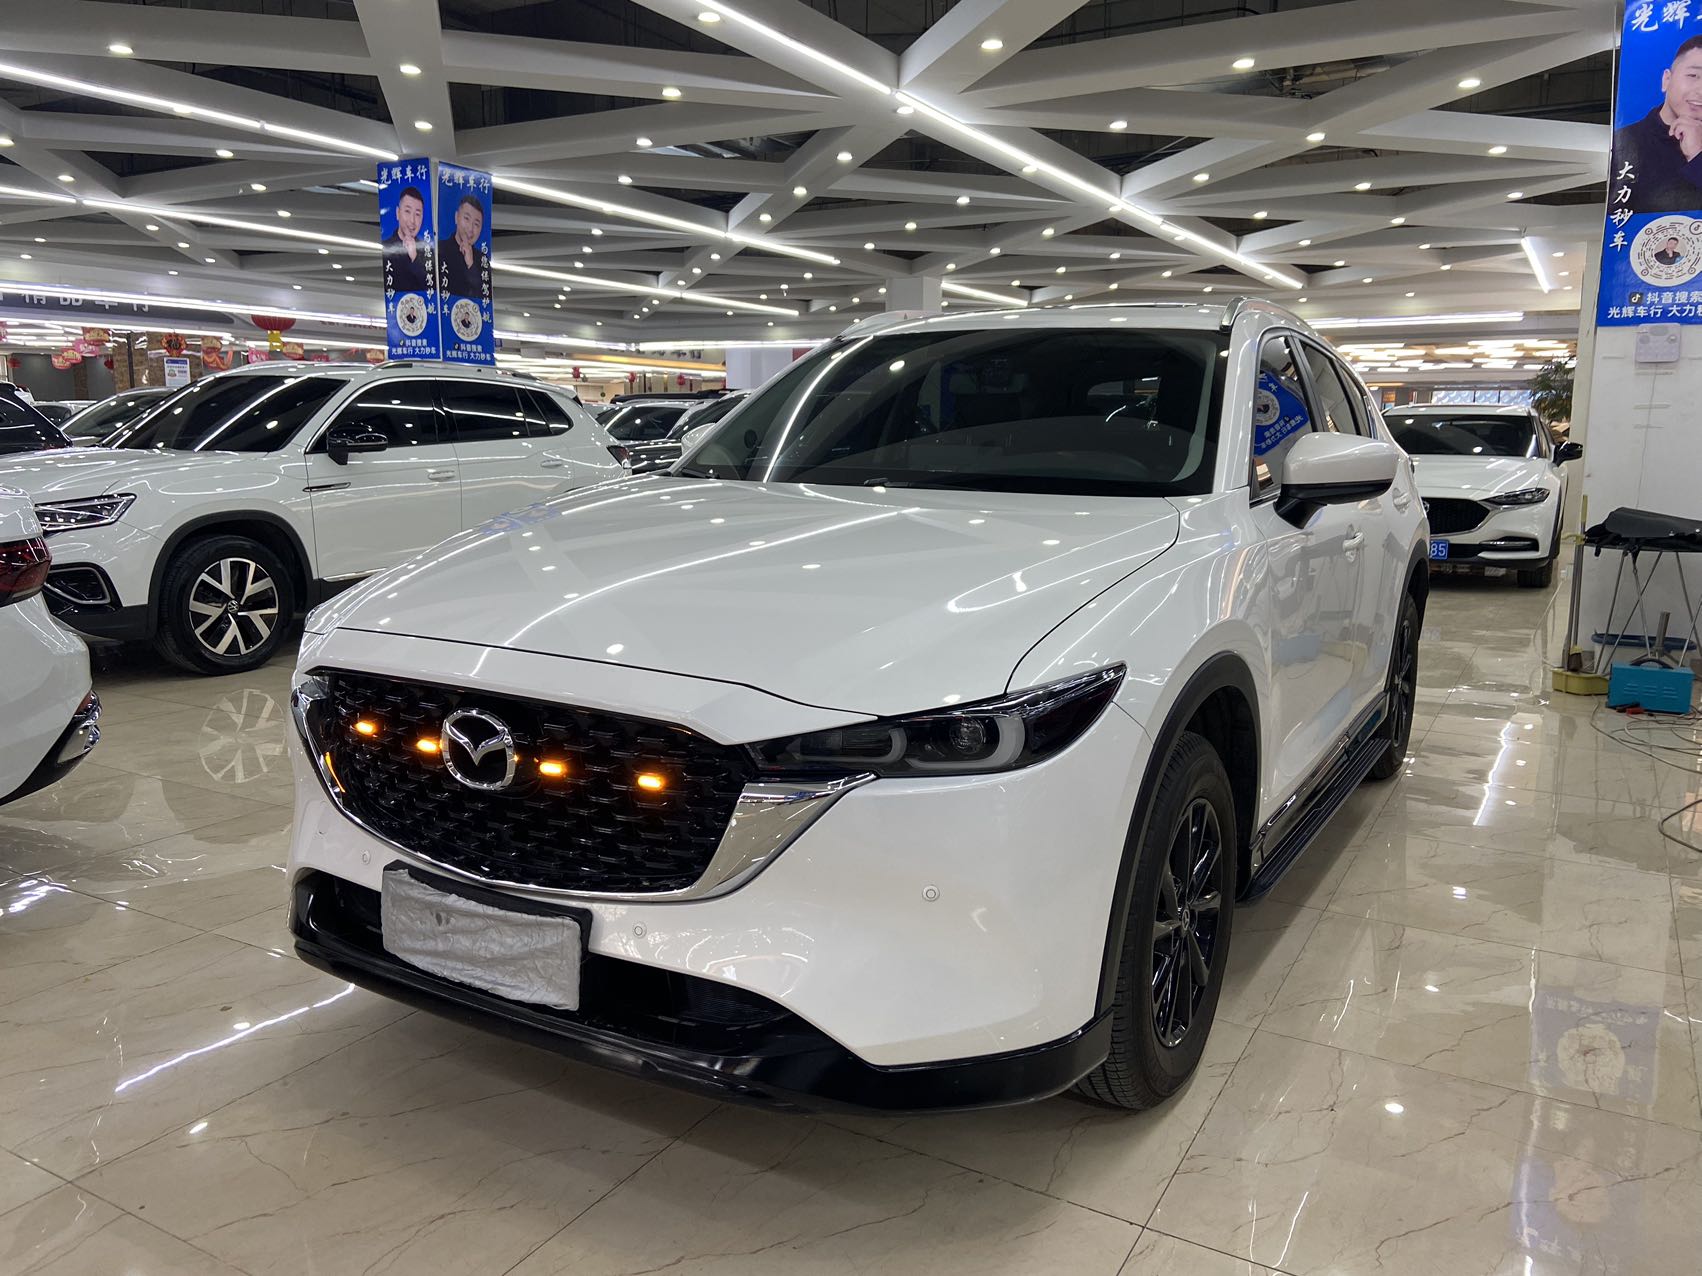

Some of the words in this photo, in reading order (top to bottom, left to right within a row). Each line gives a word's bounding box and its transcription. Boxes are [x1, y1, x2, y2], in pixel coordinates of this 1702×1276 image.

[378, 164, 427, 185] 光辉车行
[441, 168, 490, 194] 光辉车行
[1609, 161, 1636, 253] 大力秒车
[385, 259, 396, 314] 大力秒车
[440, 260, 451, 317] 大力秒车
[1646, 290, 1702, 305] 抖音搜索
[1607, 304, 1663, 319] 光辉车行
[1430, 543, 1446, 556] 85
